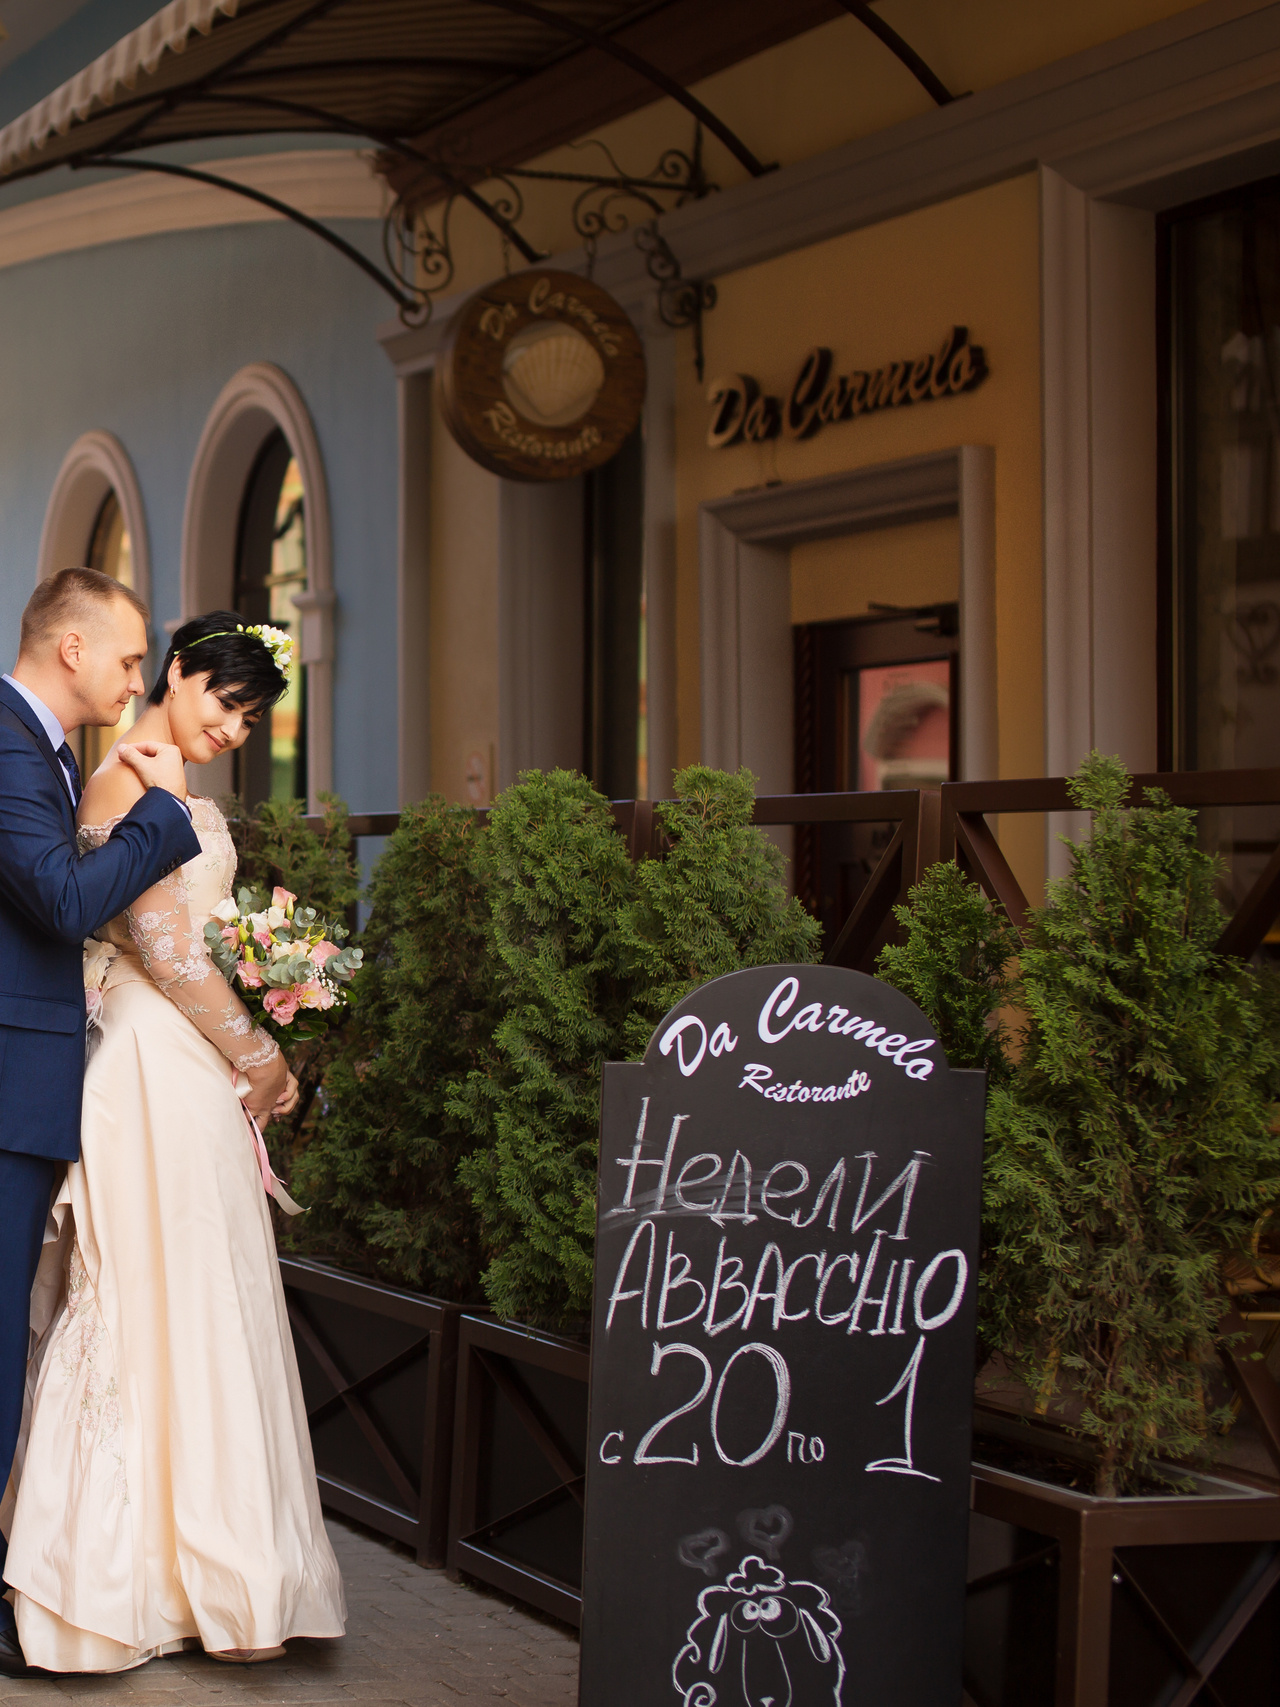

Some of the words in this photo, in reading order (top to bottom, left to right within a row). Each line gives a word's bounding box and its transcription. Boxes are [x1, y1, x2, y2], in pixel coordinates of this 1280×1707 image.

[480, 303, 518, 340] Da
[529, 278, 621, 357] Carmelo
[482, 400, 602, 459] Ristorante
[707, 373, 778, 447] Da
[782, 325, 987, 440] Carmelo
[658, 1014, 739, 1078] Da
[757, 976, 936, 1082] Carmelo
[738, 1062, 872, 1103] Ristorante
[633, 1341, 791, 1467] 20
[865, 1334, 942, 1483] 1
